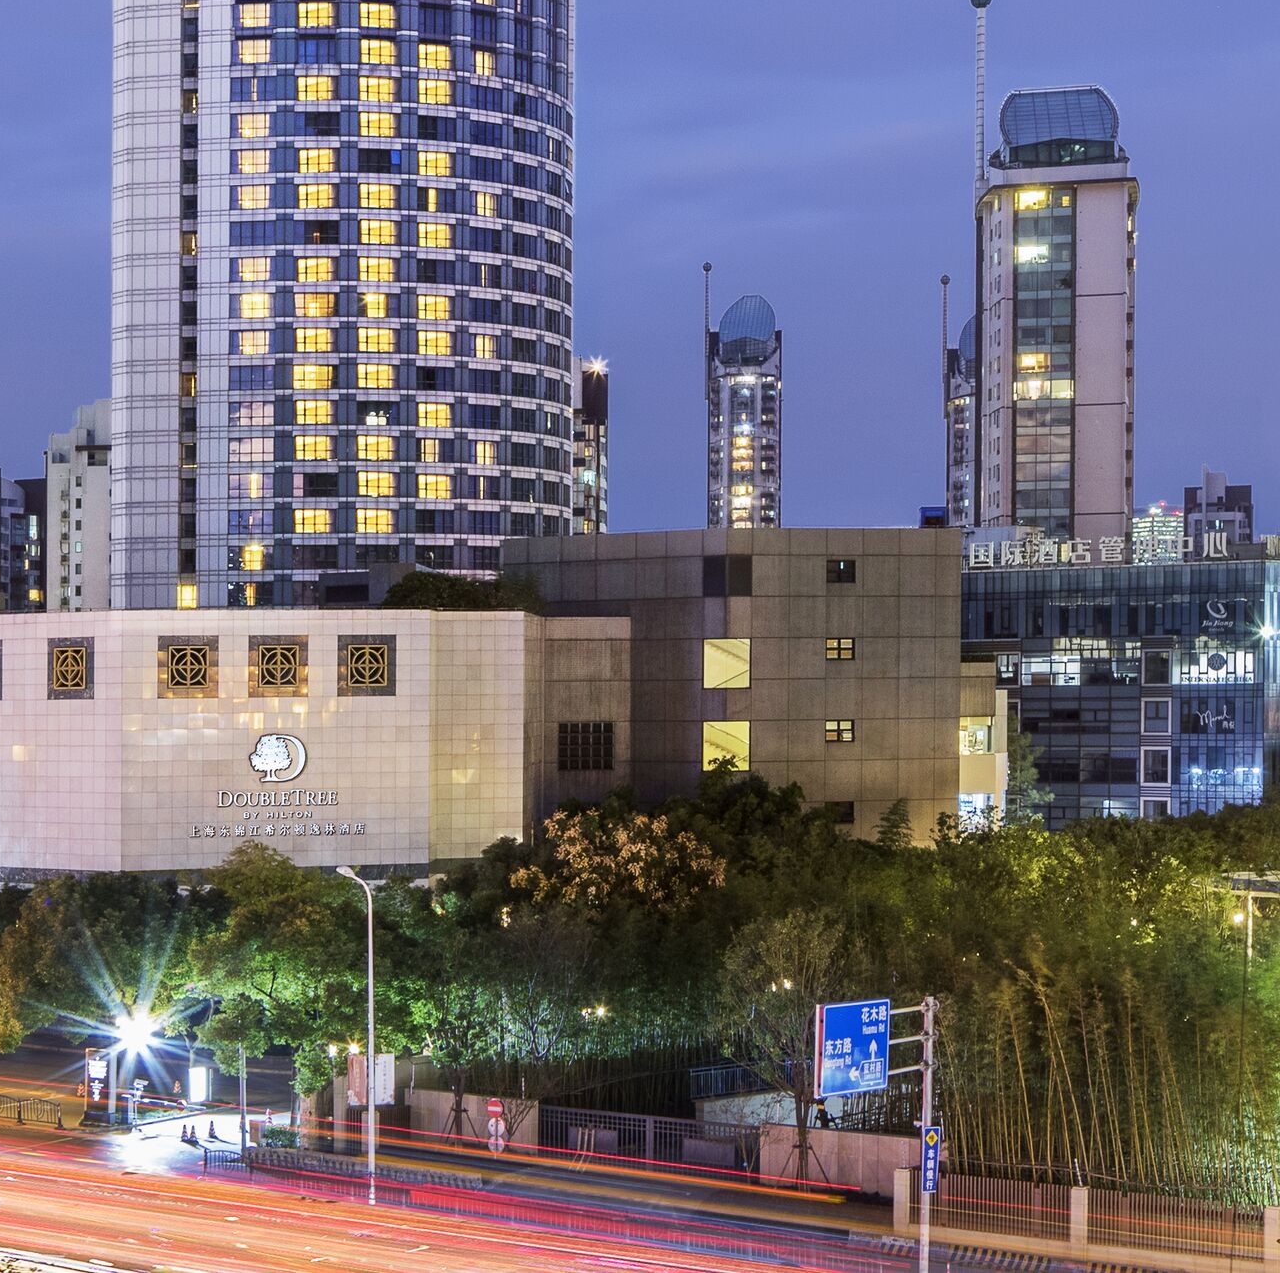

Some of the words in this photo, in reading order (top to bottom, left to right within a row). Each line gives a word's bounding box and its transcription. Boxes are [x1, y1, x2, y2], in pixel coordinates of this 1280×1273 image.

[969, 531, 1228, 568] 国际酒店管理中心
[266, 811, 313, 819] HILTON
[189, 823, 366, 838] 上海东锦江希尔顿逸林酒店
[861, 1005, 887, 1023] 花木路
[879, 1023, 885, 1033] Rd
[825, 1037, 852, 1055] 东方路
[845, 1055, 852, 1065] Rd
